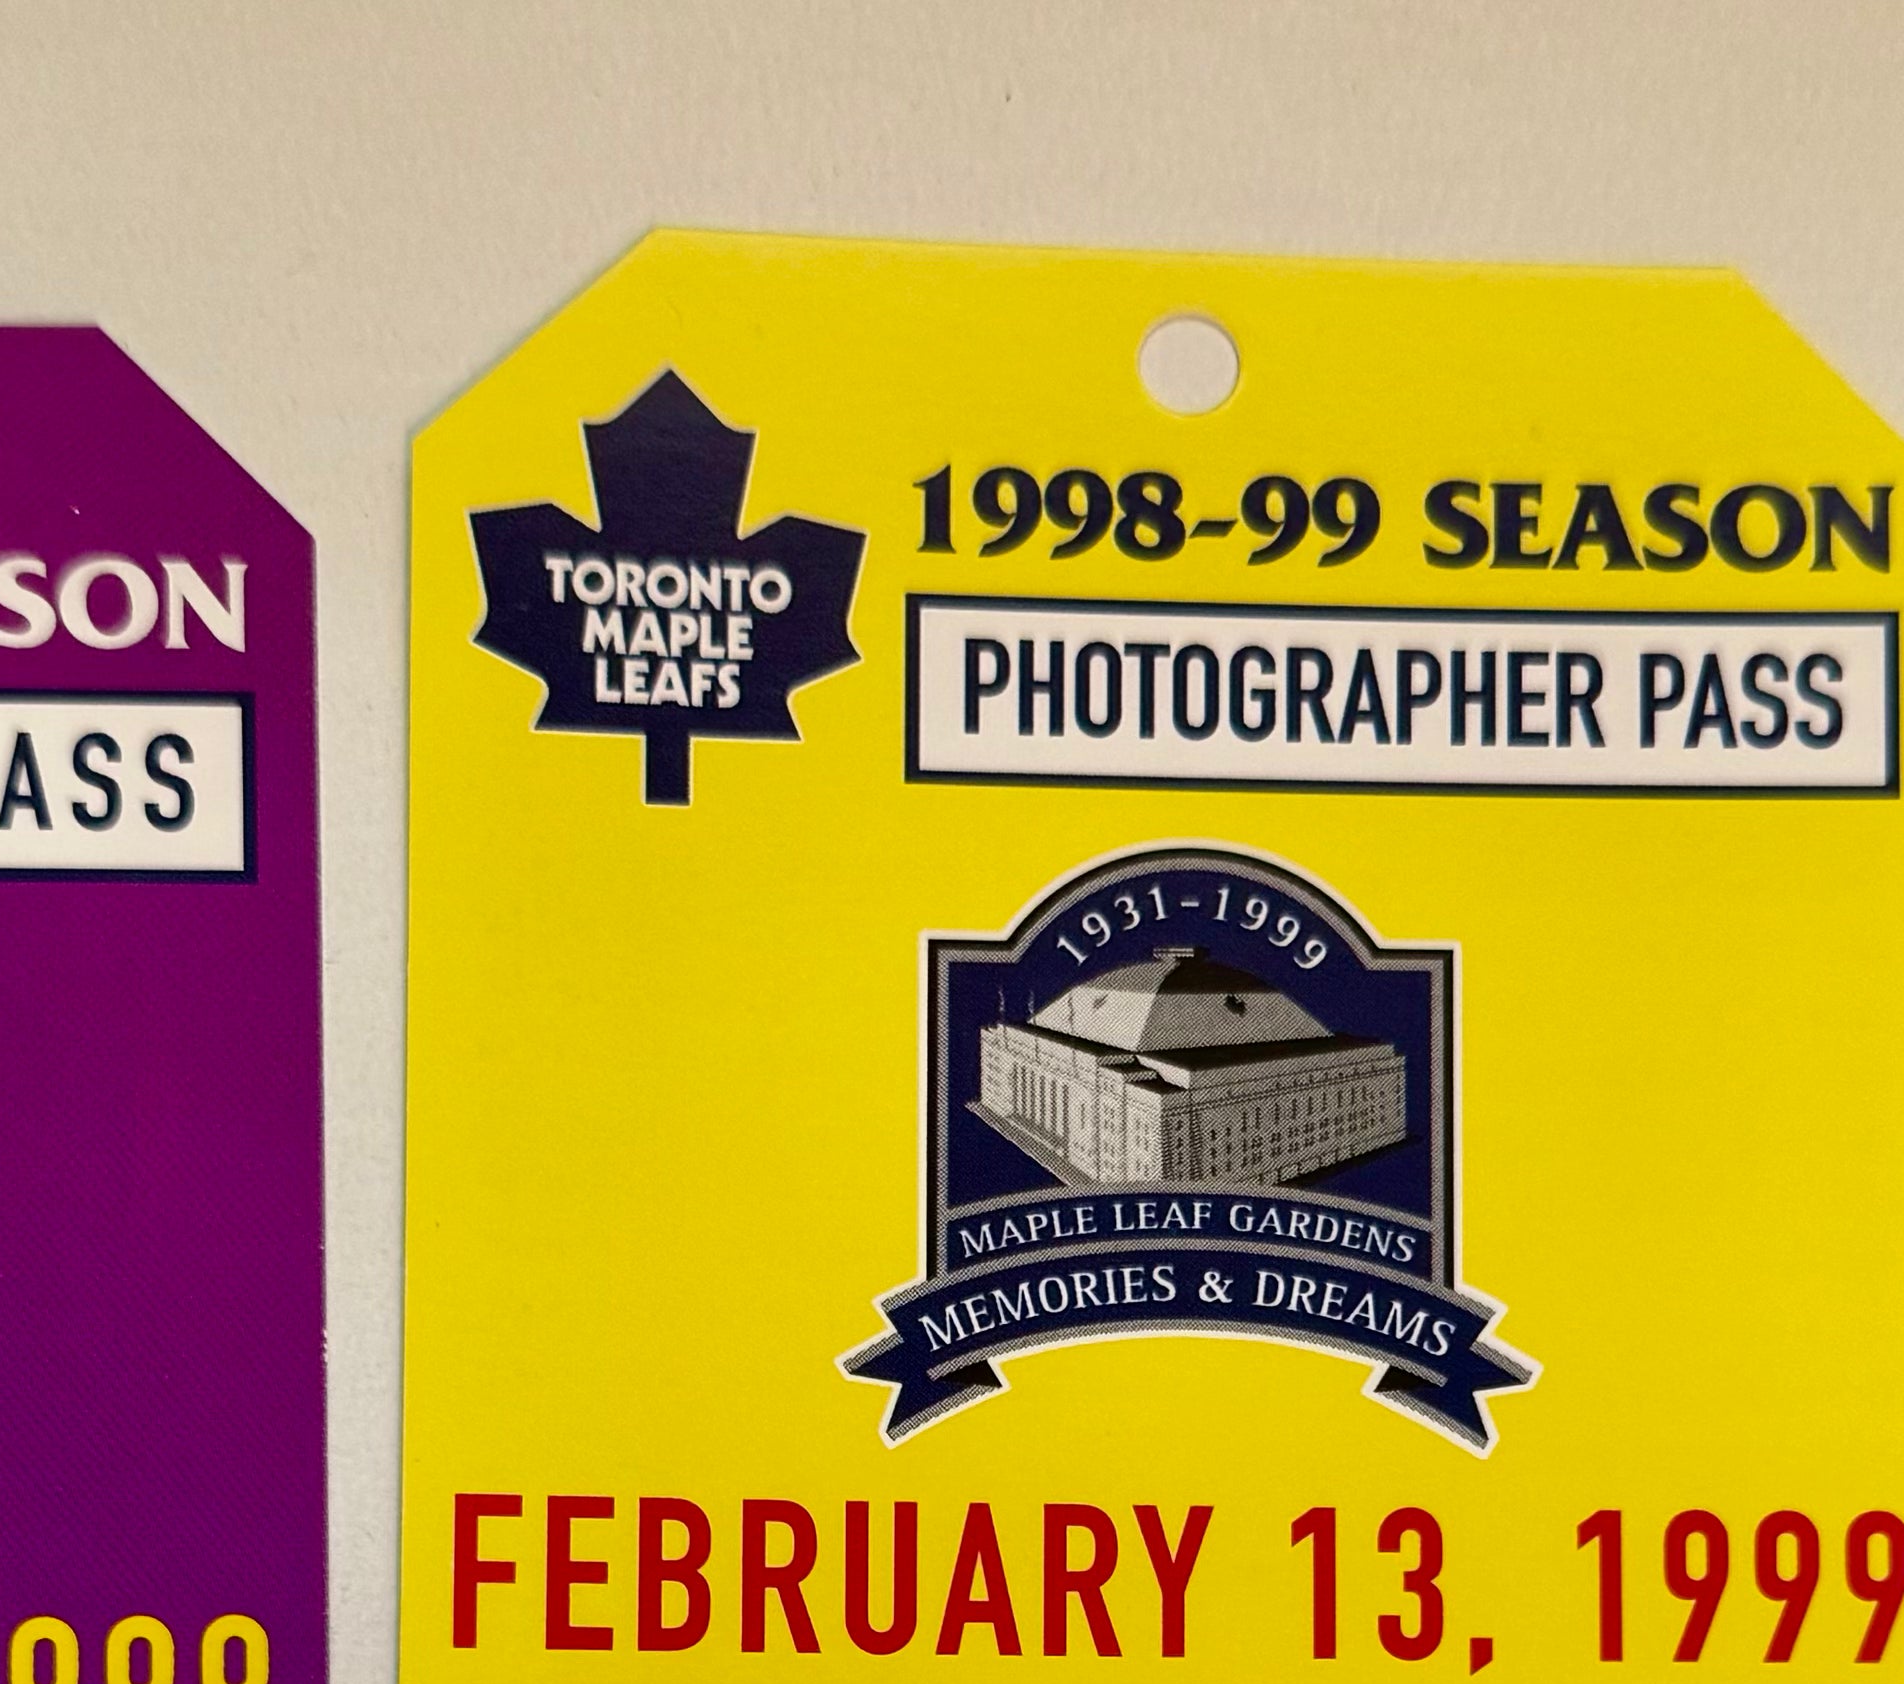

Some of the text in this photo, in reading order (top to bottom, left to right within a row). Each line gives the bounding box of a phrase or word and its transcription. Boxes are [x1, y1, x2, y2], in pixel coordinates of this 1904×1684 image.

[915, 462, 1894, 575] 1998-99 SEASON
[545, 557, 793, 612] TORONTO
[581, 612, 756, 662] MAPLE
[594, 660, 741, 711] LEAFS
[962, 640, 1846, 751] PHOTOGRAPHER PASS
[1055, 884, 1331, 973] 1931-1999
[958, 1198, 1419, 1265] MAPLE LEAF GARDENS
[921, 1263, 1460, 1359] MEMORIES & DREAMS
[450, 1493, 1215, 1659] FEBRUARY
[1290, 1505, 1496, 1675] 13,
